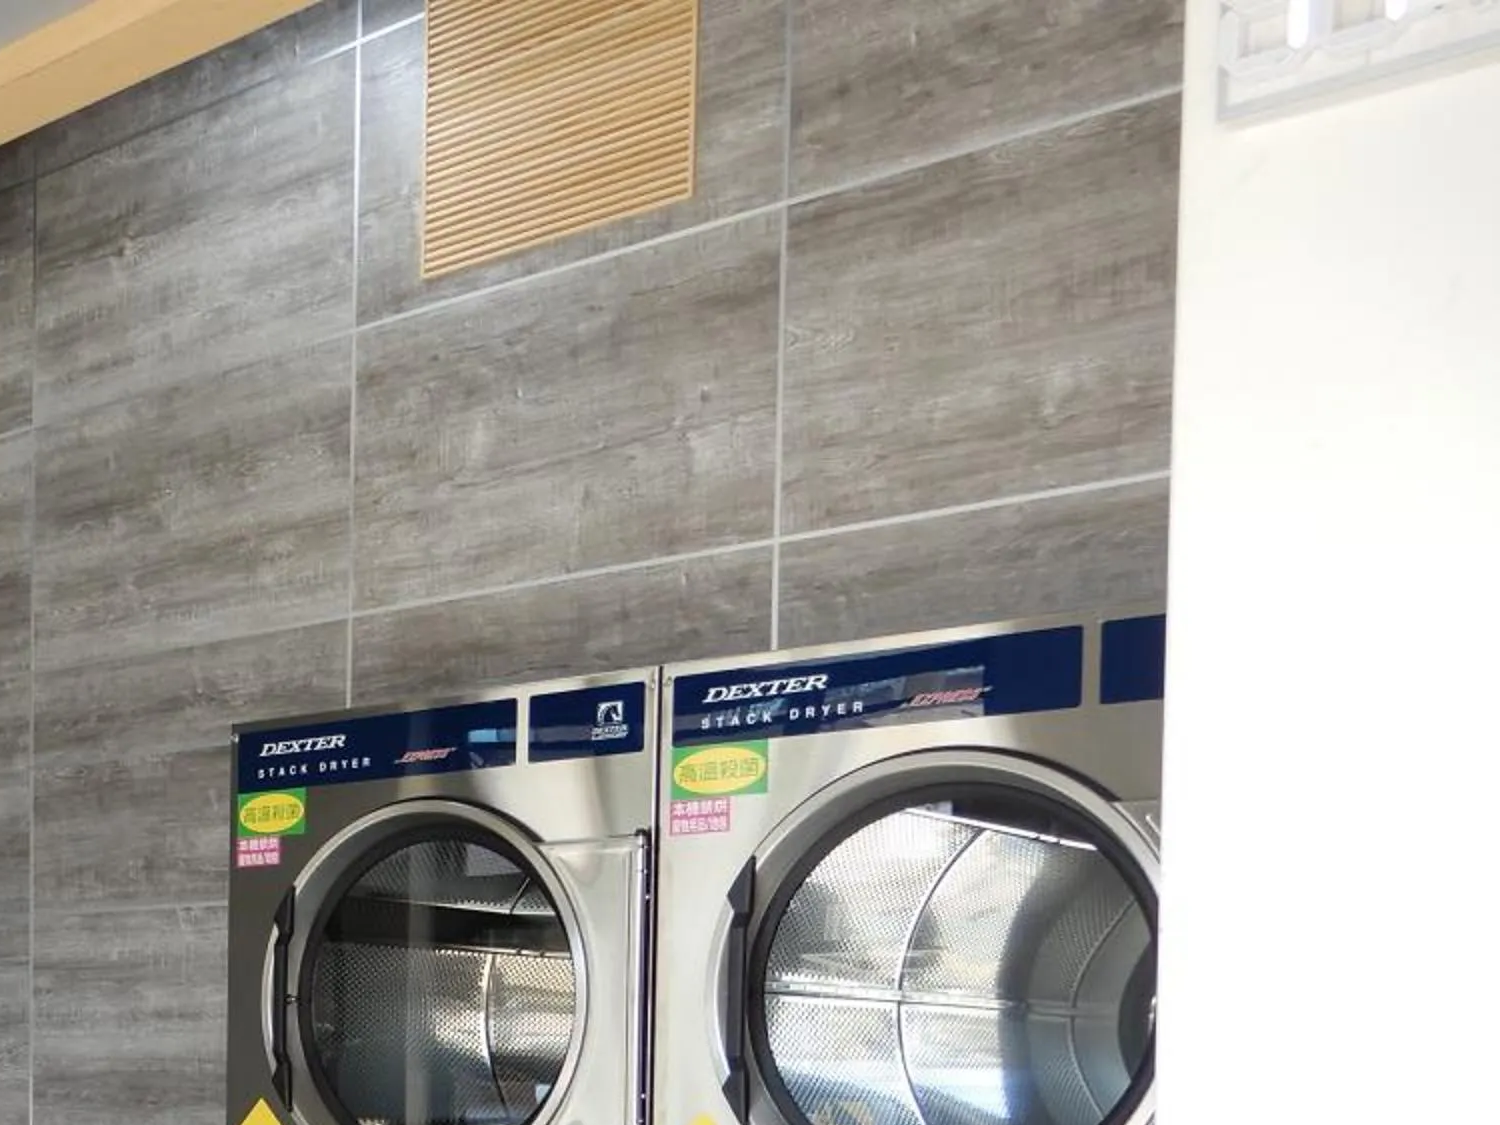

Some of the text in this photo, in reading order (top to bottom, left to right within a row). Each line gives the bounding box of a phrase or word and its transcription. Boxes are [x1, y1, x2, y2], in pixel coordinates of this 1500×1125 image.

[702, 674, 828, 704] DEXTER
[700, 700, 864, 730] STACK DRYER
[259, 734, 347, 757] DEXTER
[257, 757, 371, 779] STACK DRYER
